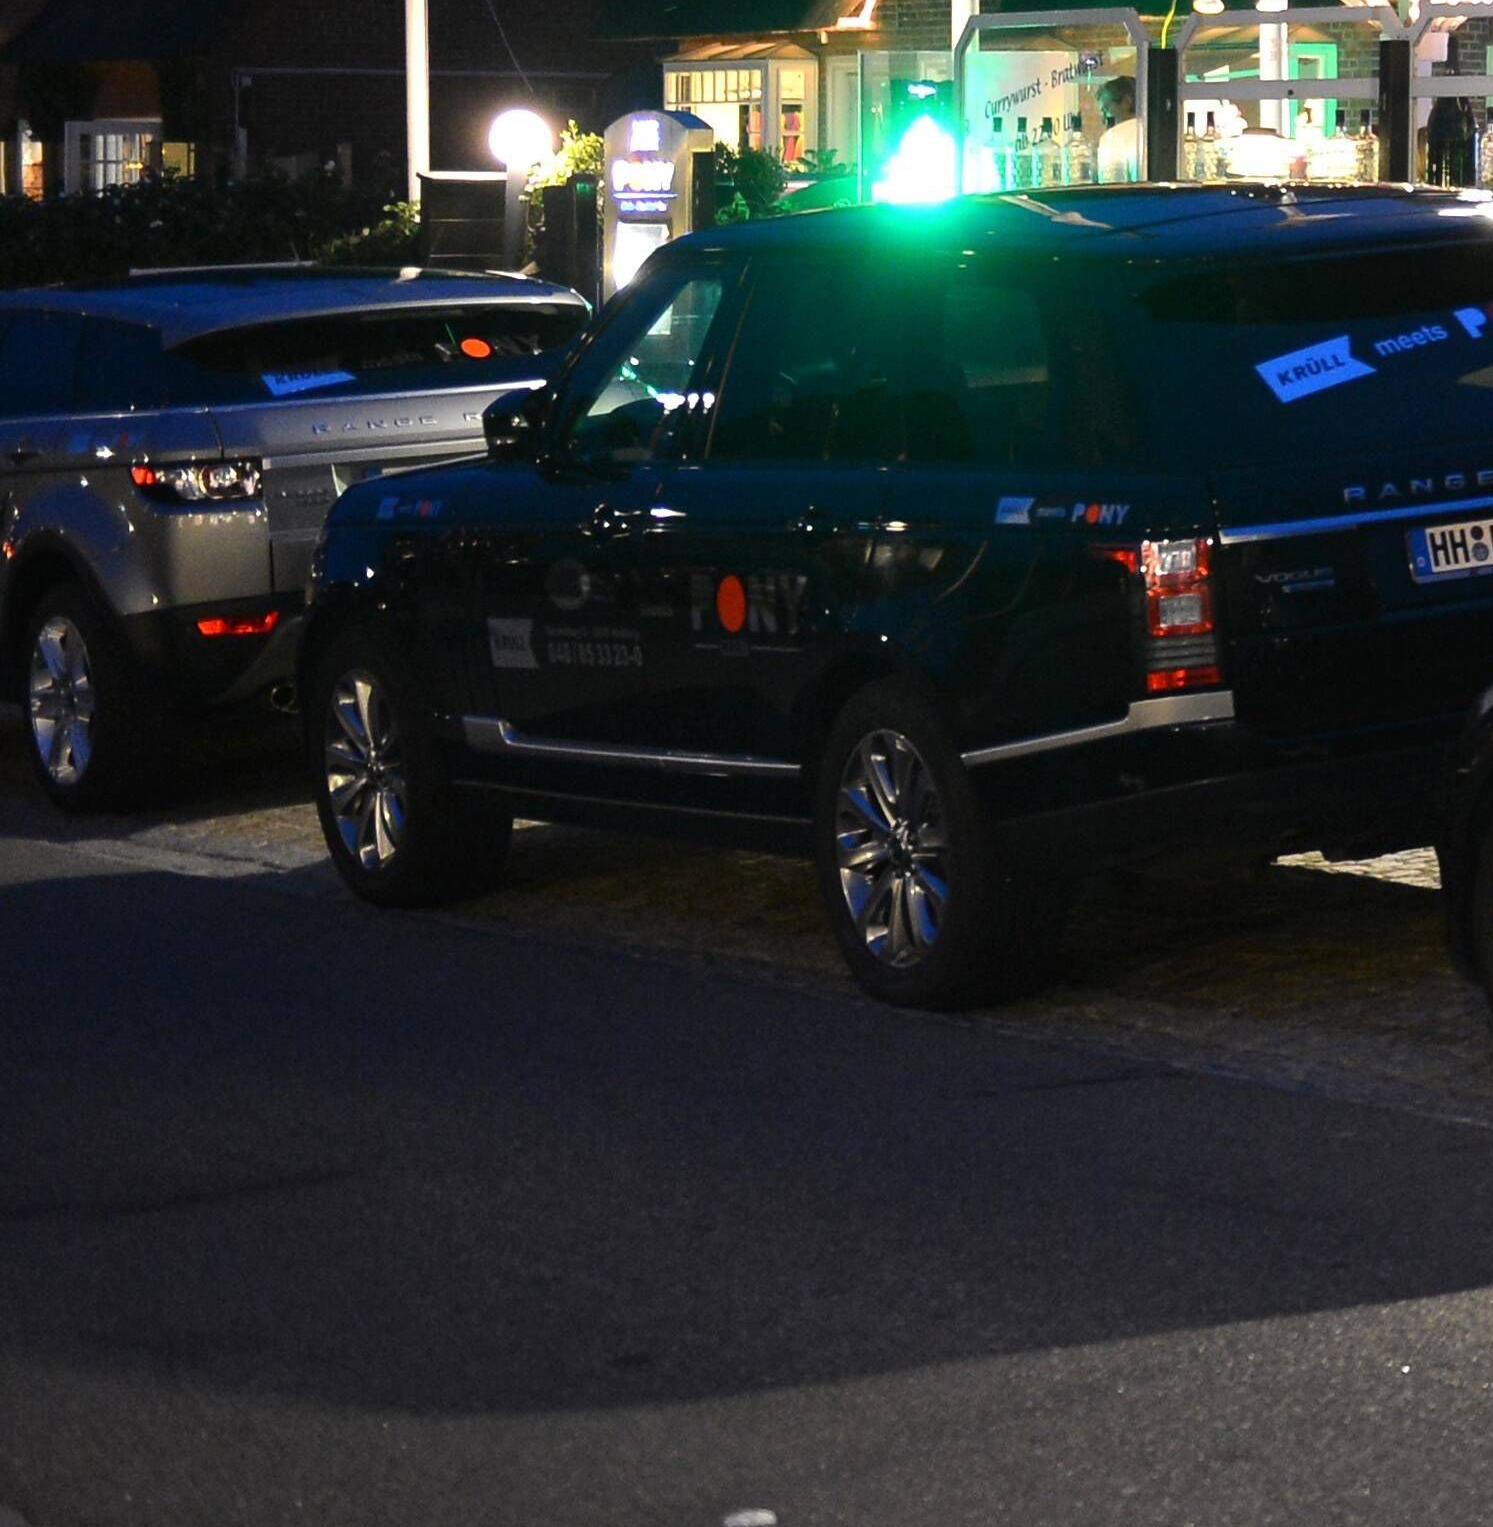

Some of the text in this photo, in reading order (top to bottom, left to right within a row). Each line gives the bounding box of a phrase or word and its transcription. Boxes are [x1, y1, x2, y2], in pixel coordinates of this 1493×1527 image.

[985, 78, 1042, 119] Currywurst
[1277, 354, 1347, 387] KRÜLL
[1375, 323, 1448, 357] meets
[312, 414, 438, 435] RANGE
[1071, 502, 1131, 526] PONY
